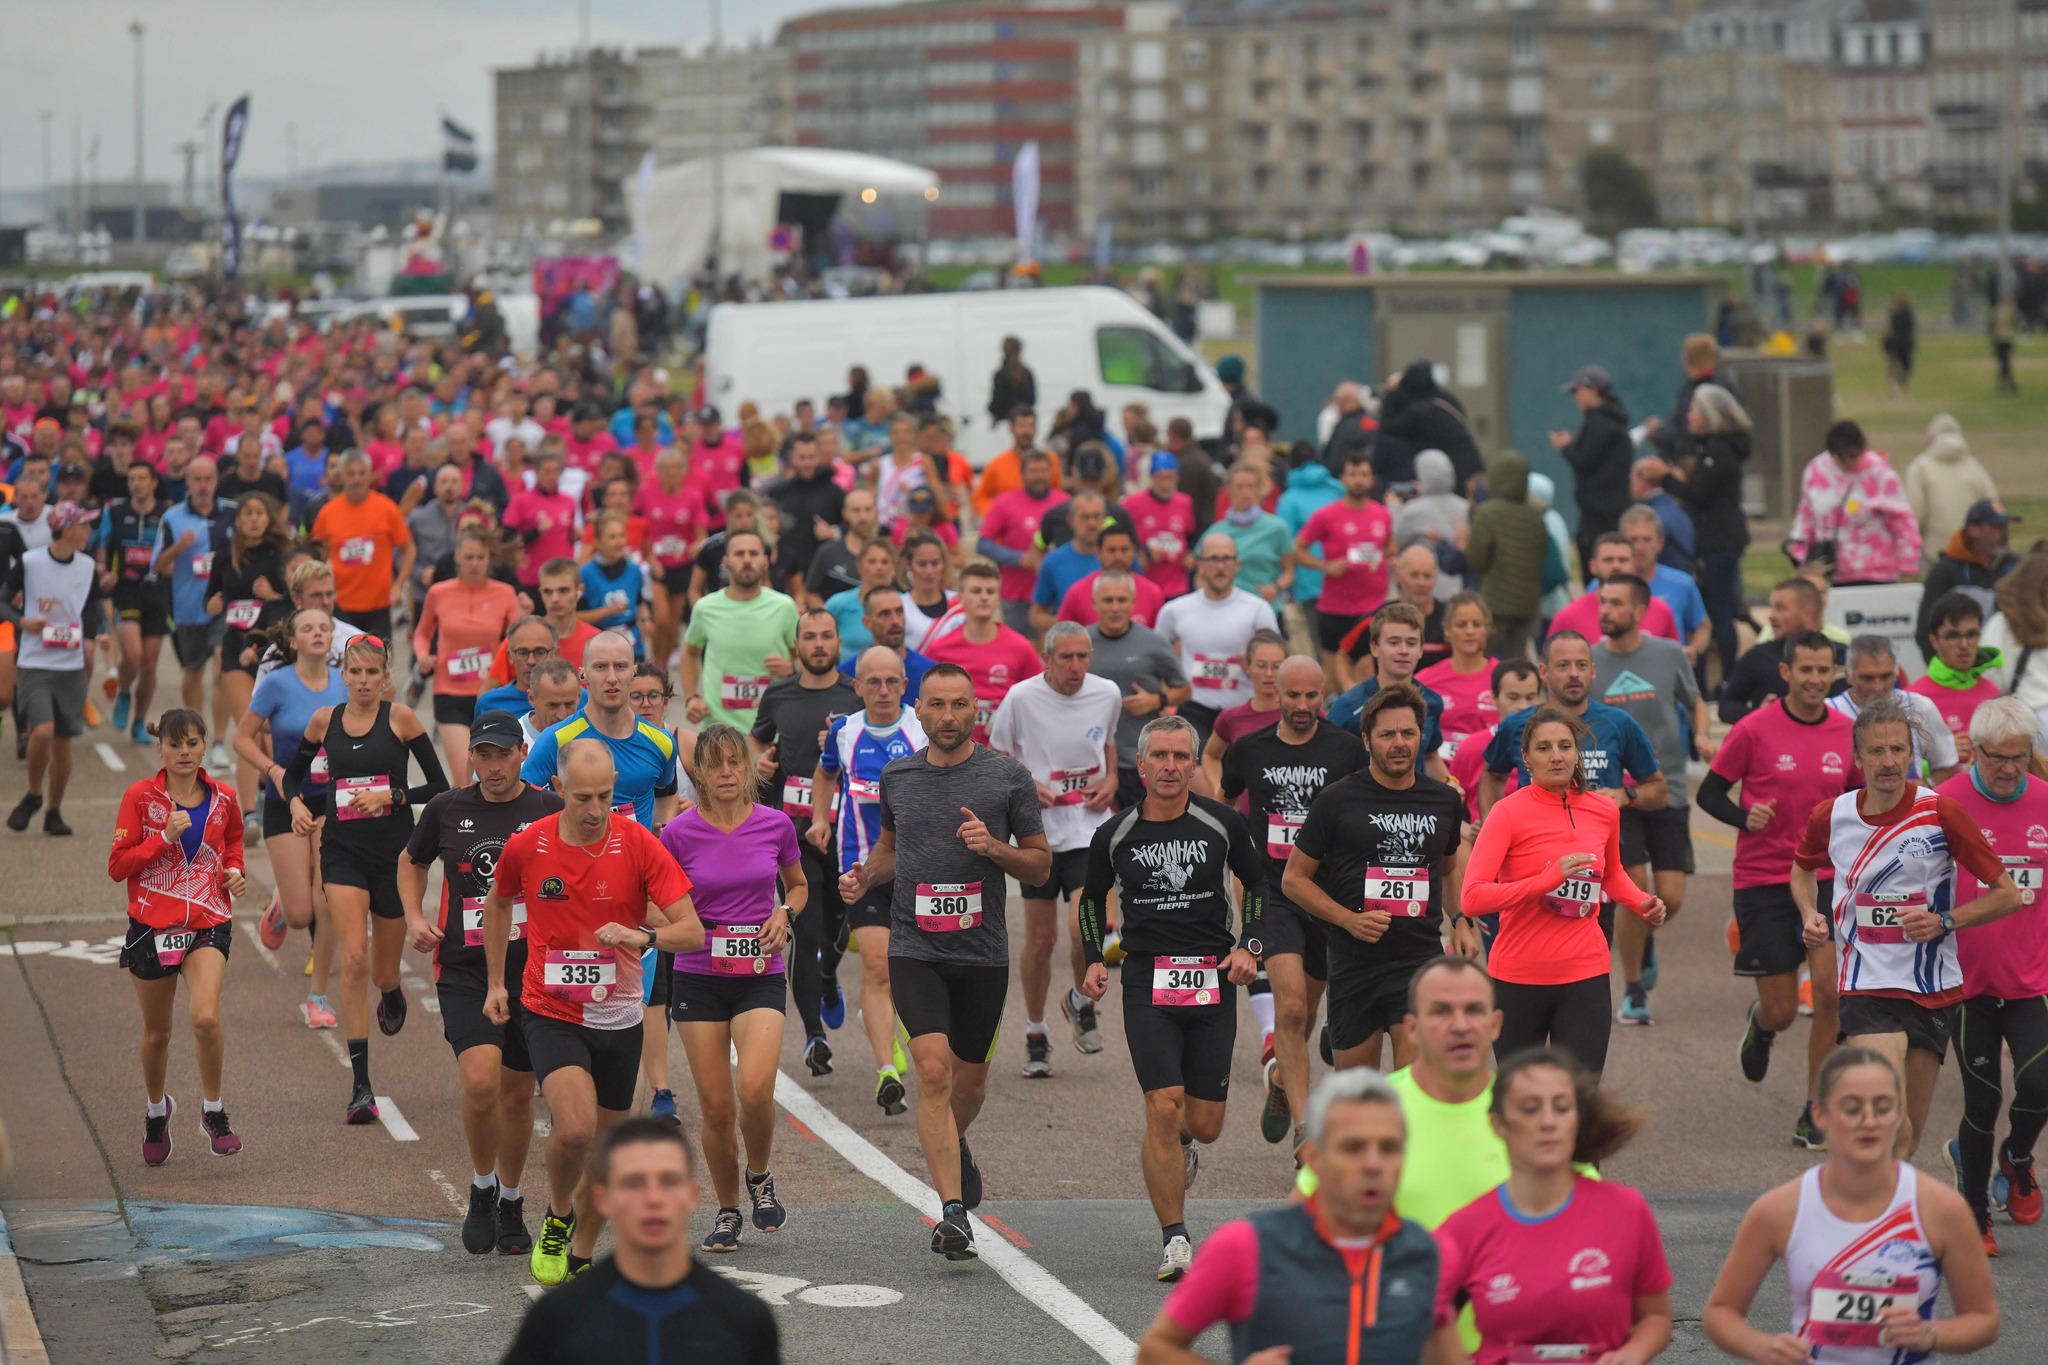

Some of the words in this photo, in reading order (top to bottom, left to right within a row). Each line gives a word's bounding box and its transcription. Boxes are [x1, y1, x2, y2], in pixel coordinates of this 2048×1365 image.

[734, 685, 759, 698] 183
[1061, 777, 1089, 793] 315
[1898, 839, 1911, 855] STADE
[1911, 836, 1932, 855] DIEPPOIS
[1380, 881, 1414, 899] 261
[1557, 880, 1591, 901] 319
[930, 896, 968, 915] 360
[1157, 902, 1190, 910] DIEPPE
[1872, 907, 1899, 926] 62
[163, 933, 192, 950] 480
[726, 938, 761, 957] 588
[561, 964, 600, 984] 335
[1168, 970, 1205, 988] 340
